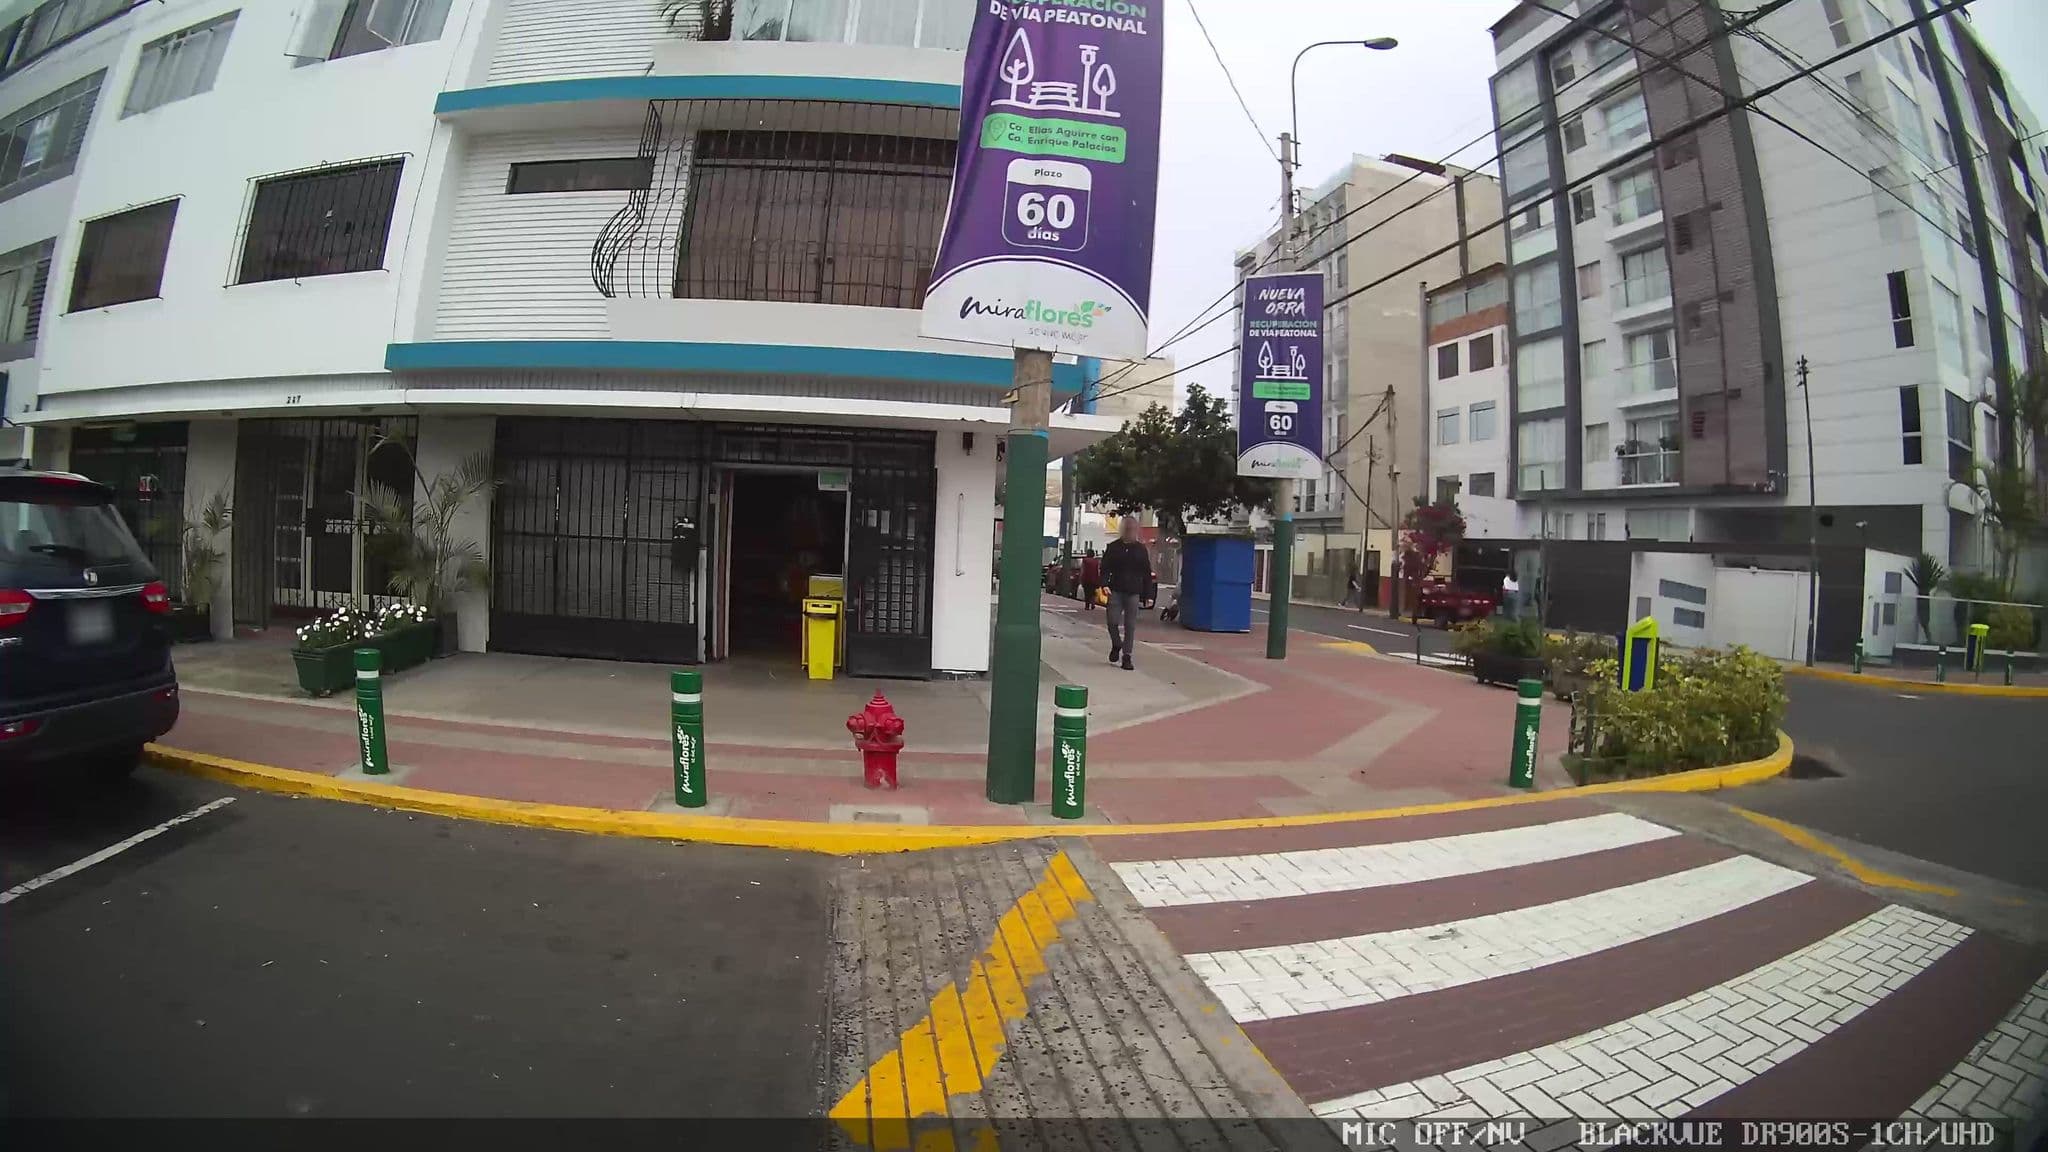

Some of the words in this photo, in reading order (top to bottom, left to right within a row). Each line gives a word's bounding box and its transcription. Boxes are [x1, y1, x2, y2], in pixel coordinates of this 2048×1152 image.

[990, 1, 1008, 20] DE
[1011, 2, 1042, 23] VÍA
[1044, 8, 1147, 35] PEATONAL
[1028, 136, 1070, 148] Enrique
[1034, 168, 1063, 179] Plazo
[1017, 192, 1075, 229] 60
[1027, 227, 1060, 242] días
[1258, 286, 1306, 301] NUEVA
[959, 296, 1094, 329] miraflores
[1265, 301, 1307, 317] OBRA
[1269, 414, 1293, 431] 60
[679, 734, 693, 794] miraflores
[1063, 747, 1078, 806] miraflores
